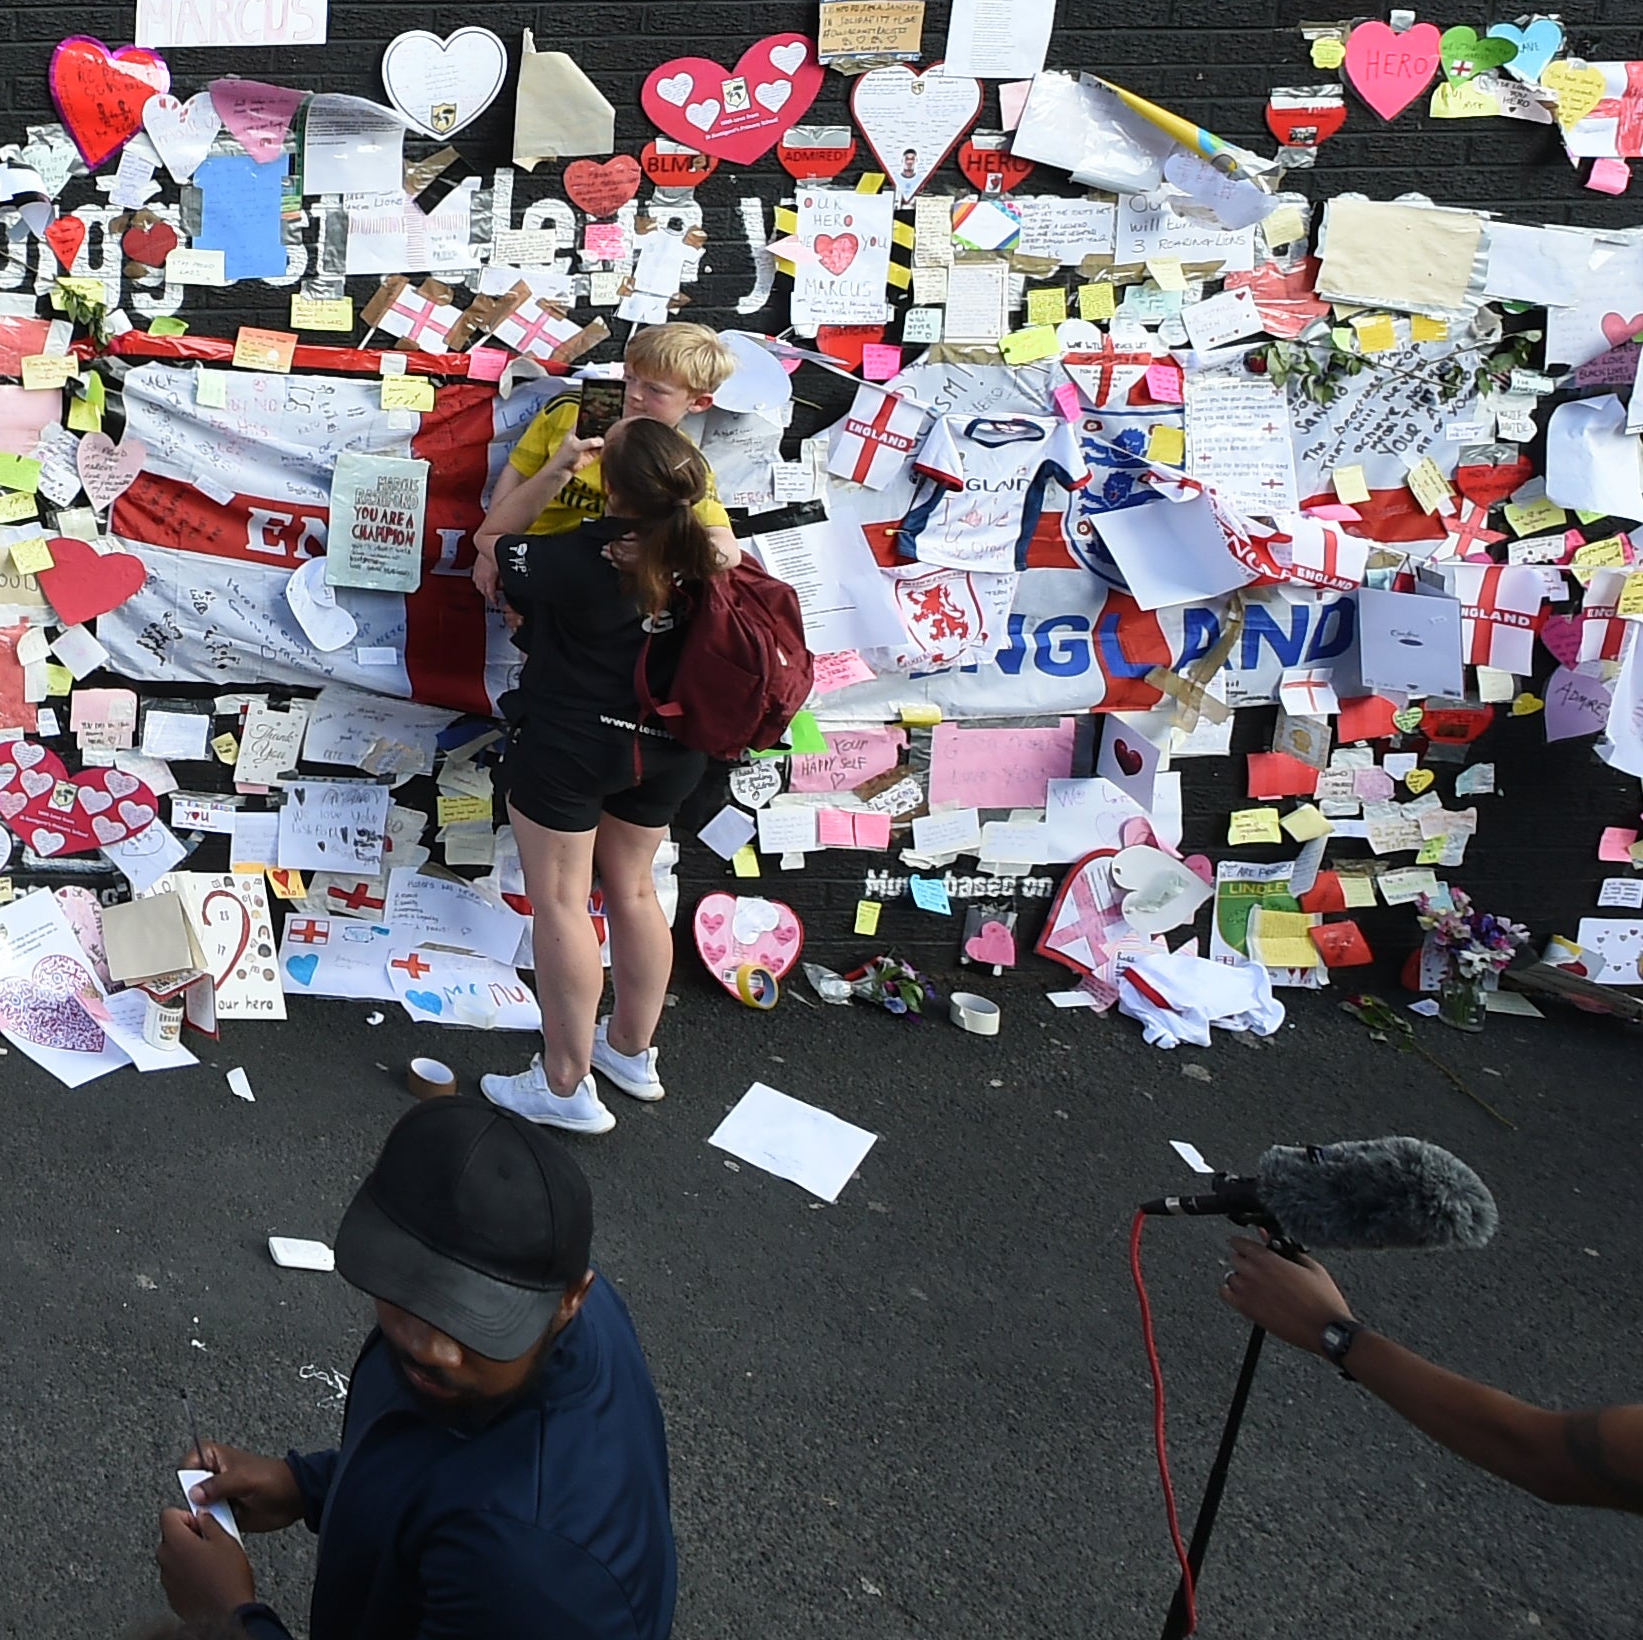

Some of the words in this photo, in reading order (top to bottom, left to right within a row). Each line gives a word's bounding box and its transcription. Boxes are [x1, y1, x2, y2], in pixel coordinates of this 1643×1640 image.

[1366, 47, 1428, 80] HERO
[783, 149, 849, 164] ADMIRED!
[803, 196, 841, 210] OUR
[812, 212, 854, 228] HERO
[1129, 217, 1160, 233] will
[860, 234, 888, 252] YOU
[1131, 239, 1146, 254] 3
[804, 278, 873, 299] MARCUS
[848, 420, 909, 449] ENGLAND
[376, 475, 420, 493] MARCUS
[354, 487, 419, 510] RASHFORD
[354, 505, 379, 523] YOU
[380, 508, 405, 527] ARE
[405, 511, 415, 529] A
[351, 523, 416, 548] CHAMPION
[1296, 567, 1353, 591] ENGLAND
[1460, 607, 1531, 627] NGLAND
[912, 597, 1358, 680] NGLAND
[249, 723, 298, 745] Thank
[251, 739, 287, 764] You
[831, 738, 869, 756] Your
[801, 760, 835, 776] HAPPY
[1022, 879, 1053, 896] on
[218, 1000, 239, 1010] our
[245, 998, 274, 1011] hero
